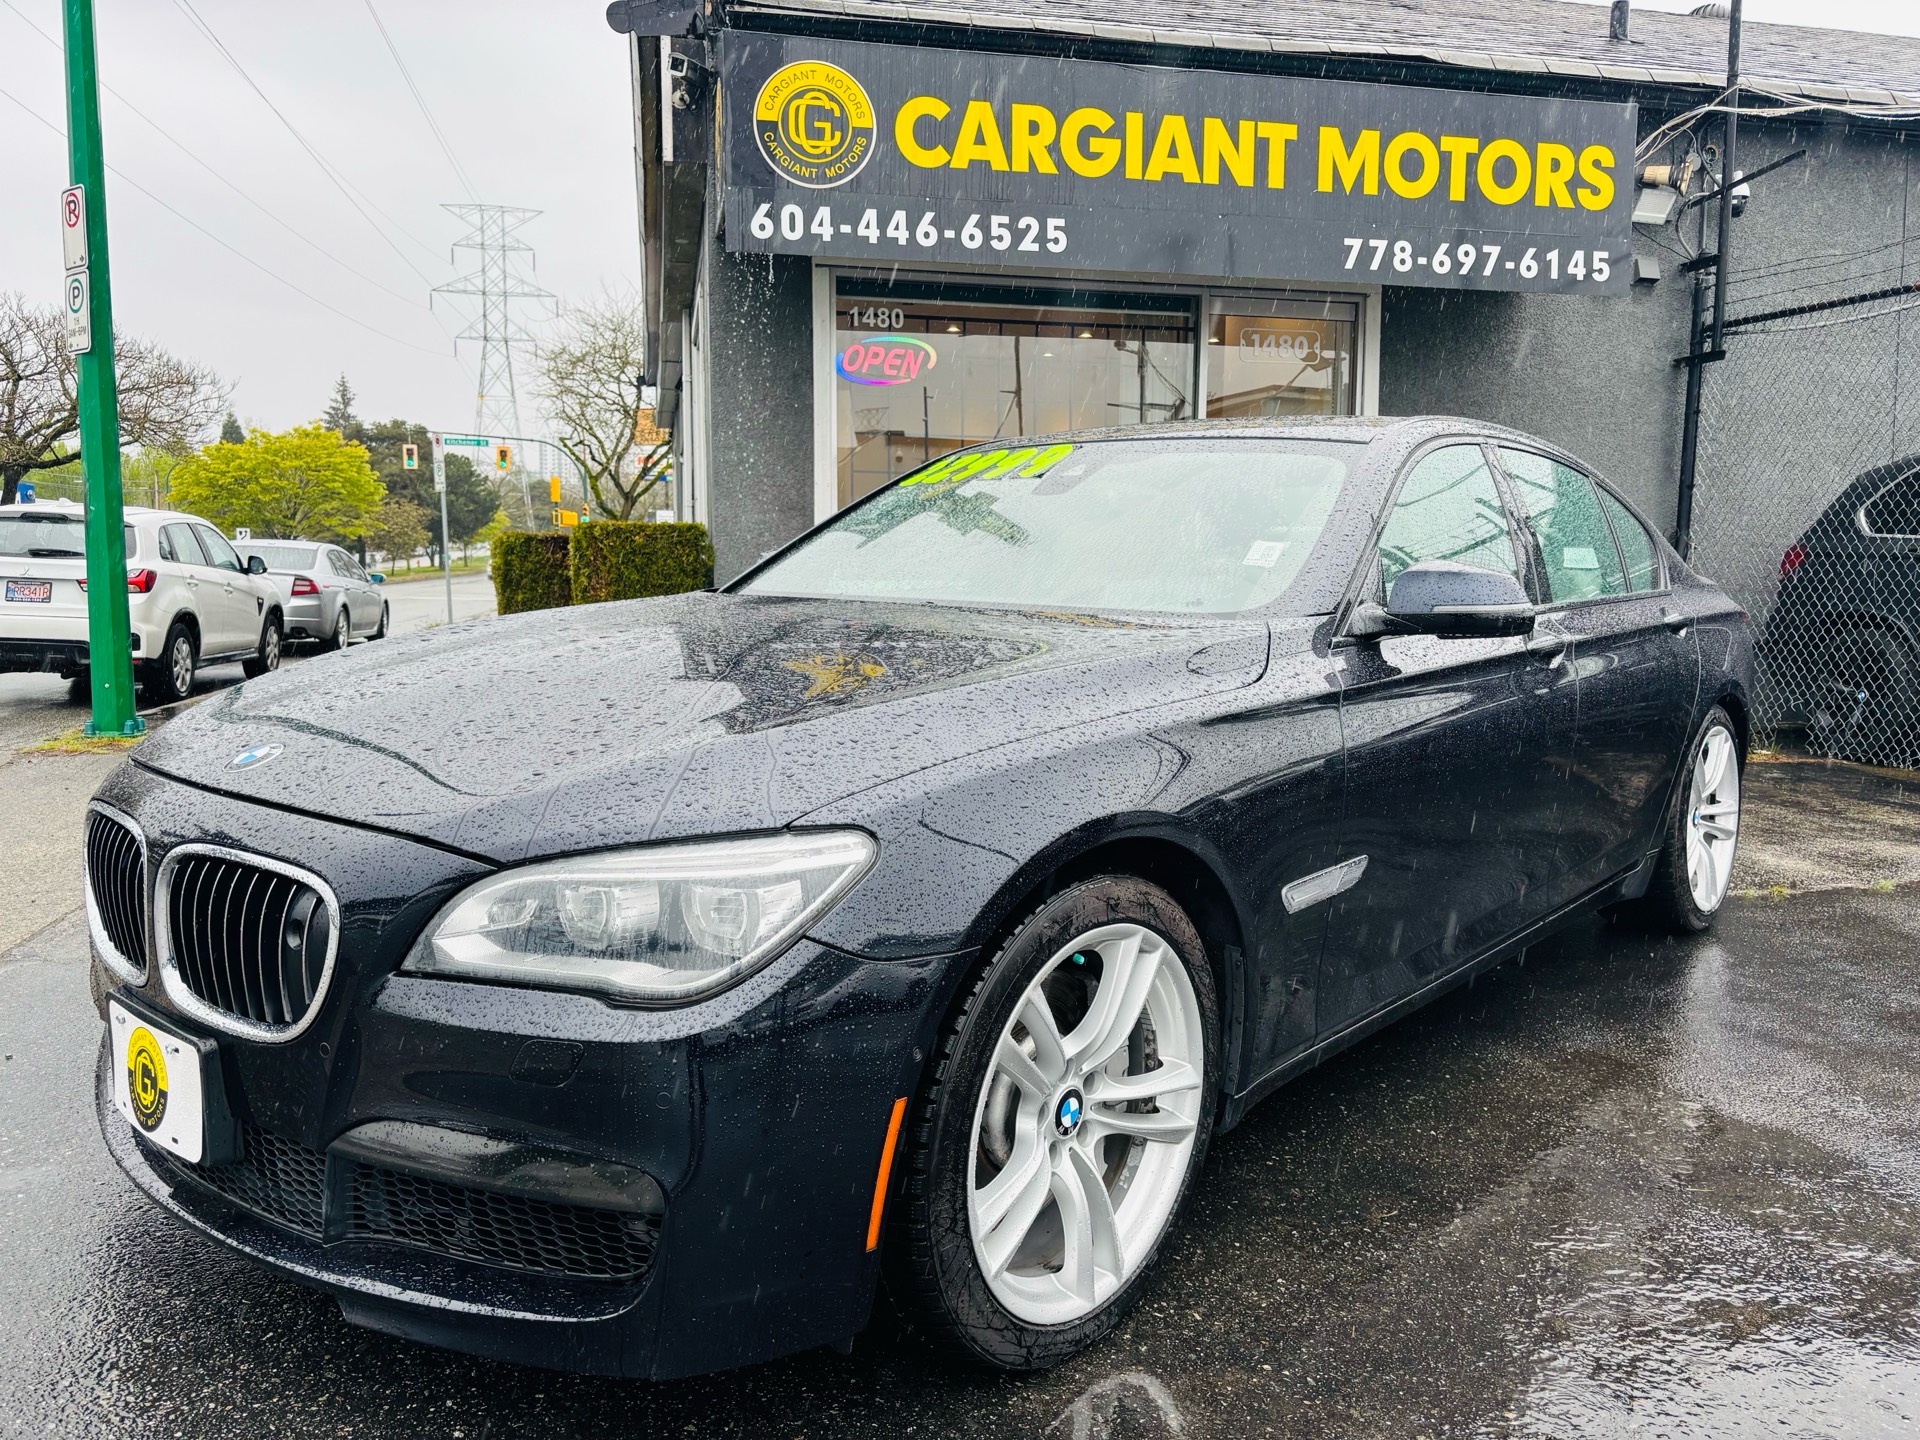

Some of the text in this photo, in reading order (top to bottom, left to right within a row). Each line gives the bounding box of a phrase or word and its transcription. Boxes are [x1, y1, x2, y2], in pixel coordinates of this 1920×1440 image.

[764, 69, 866, 119] CARGIANT MOTORS
[763, 131, 867, 179] CARGIANT MOTORS
[894, 96, 1615, 211] CARGIANT MOTORS
[750, 203, 1068, 253] 604-446-6525
[1343, 238, 1611, 282] 778-697-6145
[849, 306, 905, 329] 1480
[842, 344, 925, 379] OPEN
[1250, 333, 1309, 359] 1480
